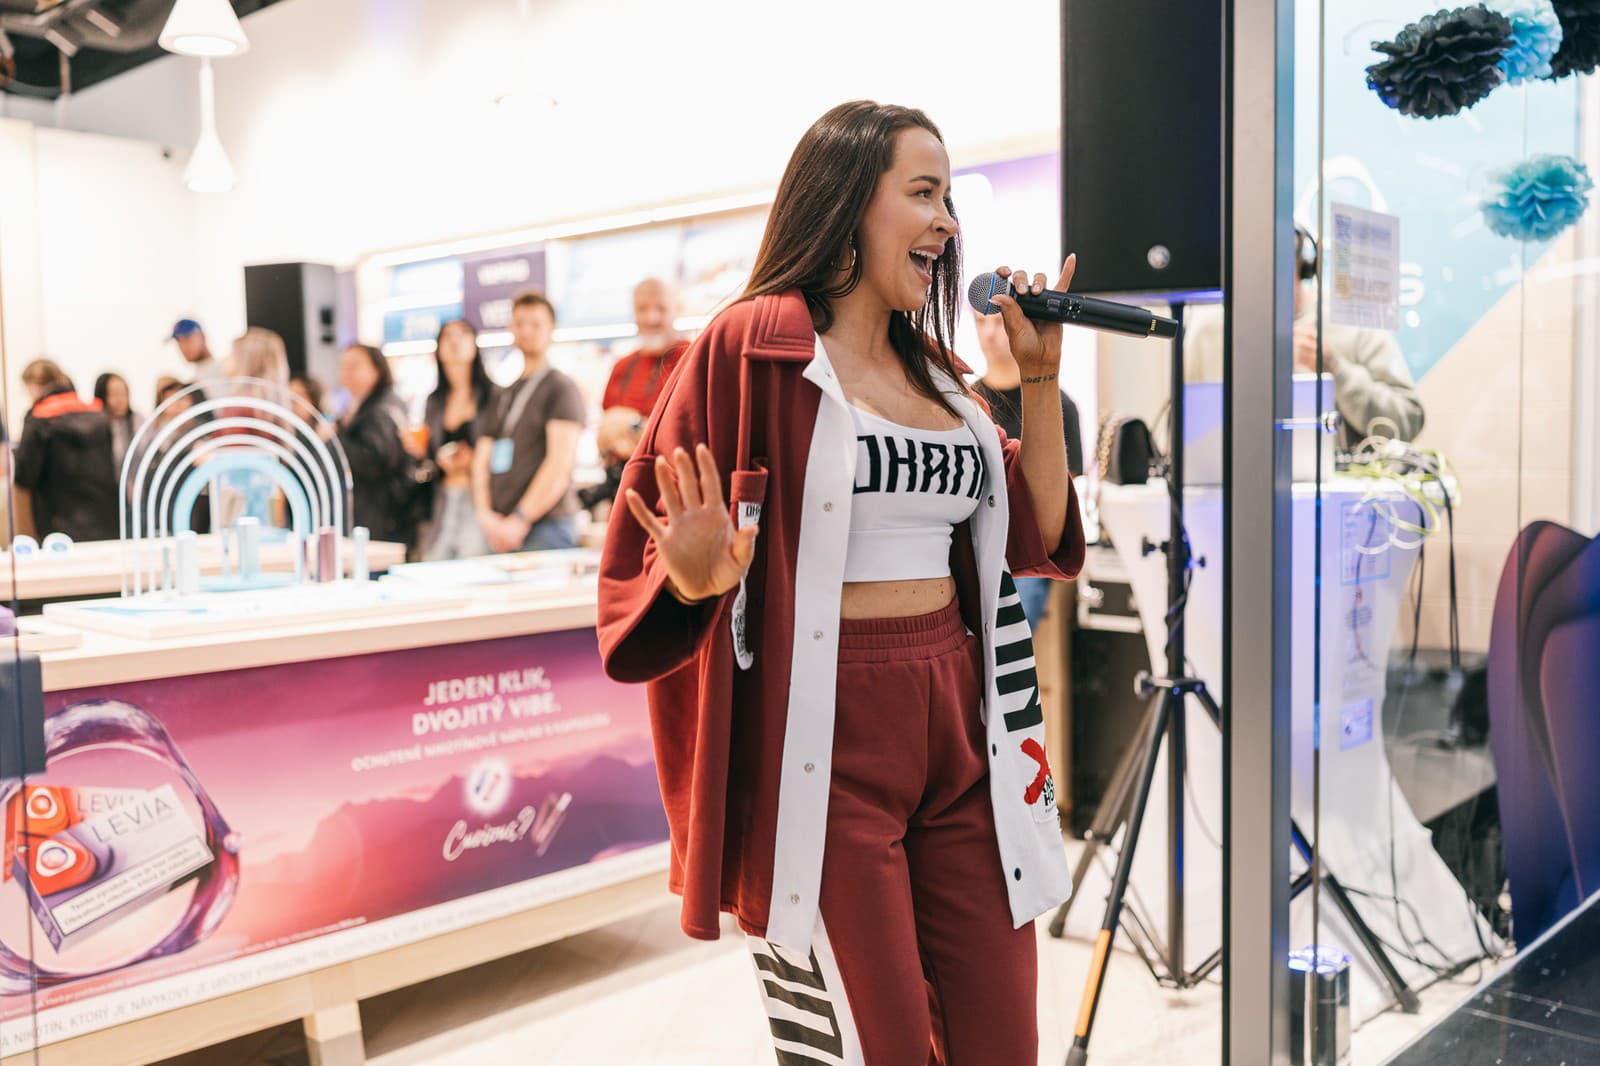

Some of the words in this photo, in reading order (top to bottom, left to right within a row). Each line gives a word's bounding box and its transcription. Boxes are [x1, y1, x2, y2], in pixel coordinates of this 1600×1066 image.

[424, 674, 495, 706] JEDEN
[498, 666, 551, 694] KLIK,
[412, 695, 506, 736] DVOJITÝ
[92, 796, 172, 843] LEVIA
